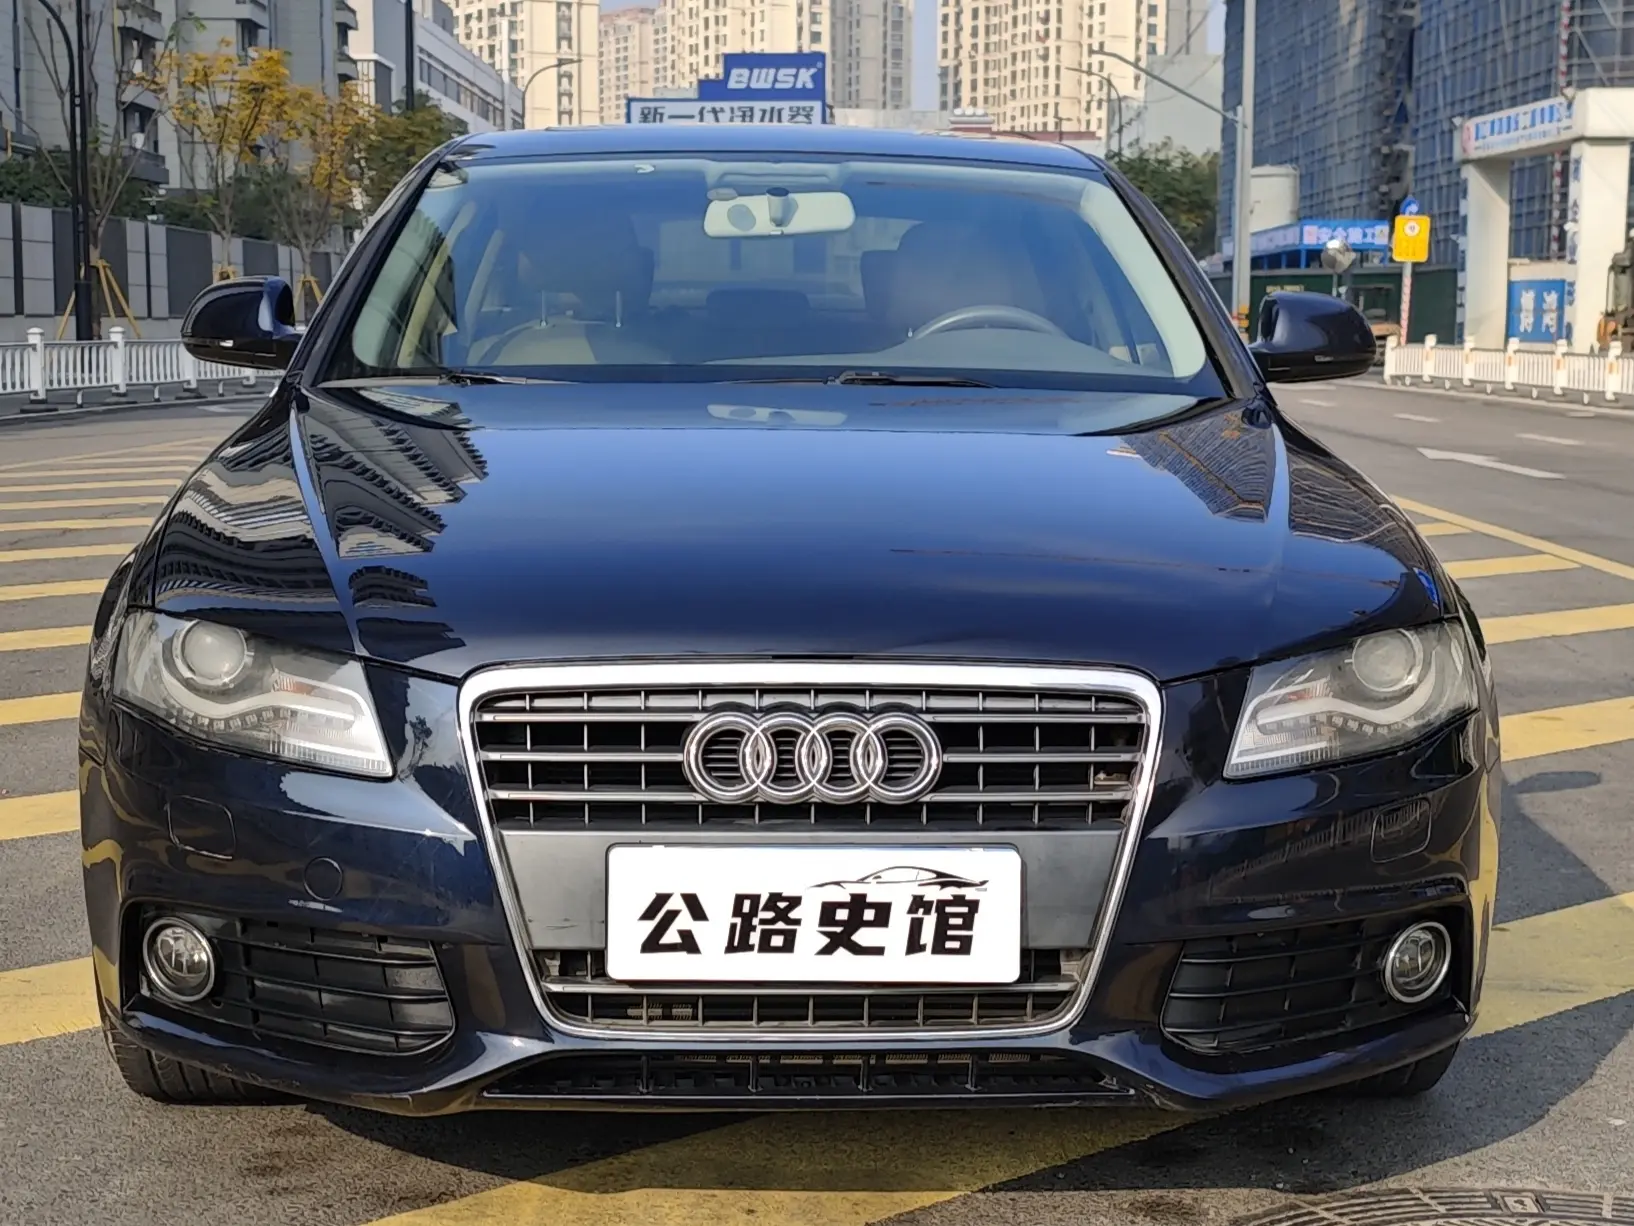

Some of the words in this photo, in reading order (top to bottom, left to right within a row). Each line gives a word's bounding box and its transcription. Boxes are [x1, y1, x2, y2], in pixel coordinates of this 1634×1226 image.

[638, 105, 815, 124] 新一代净水器
